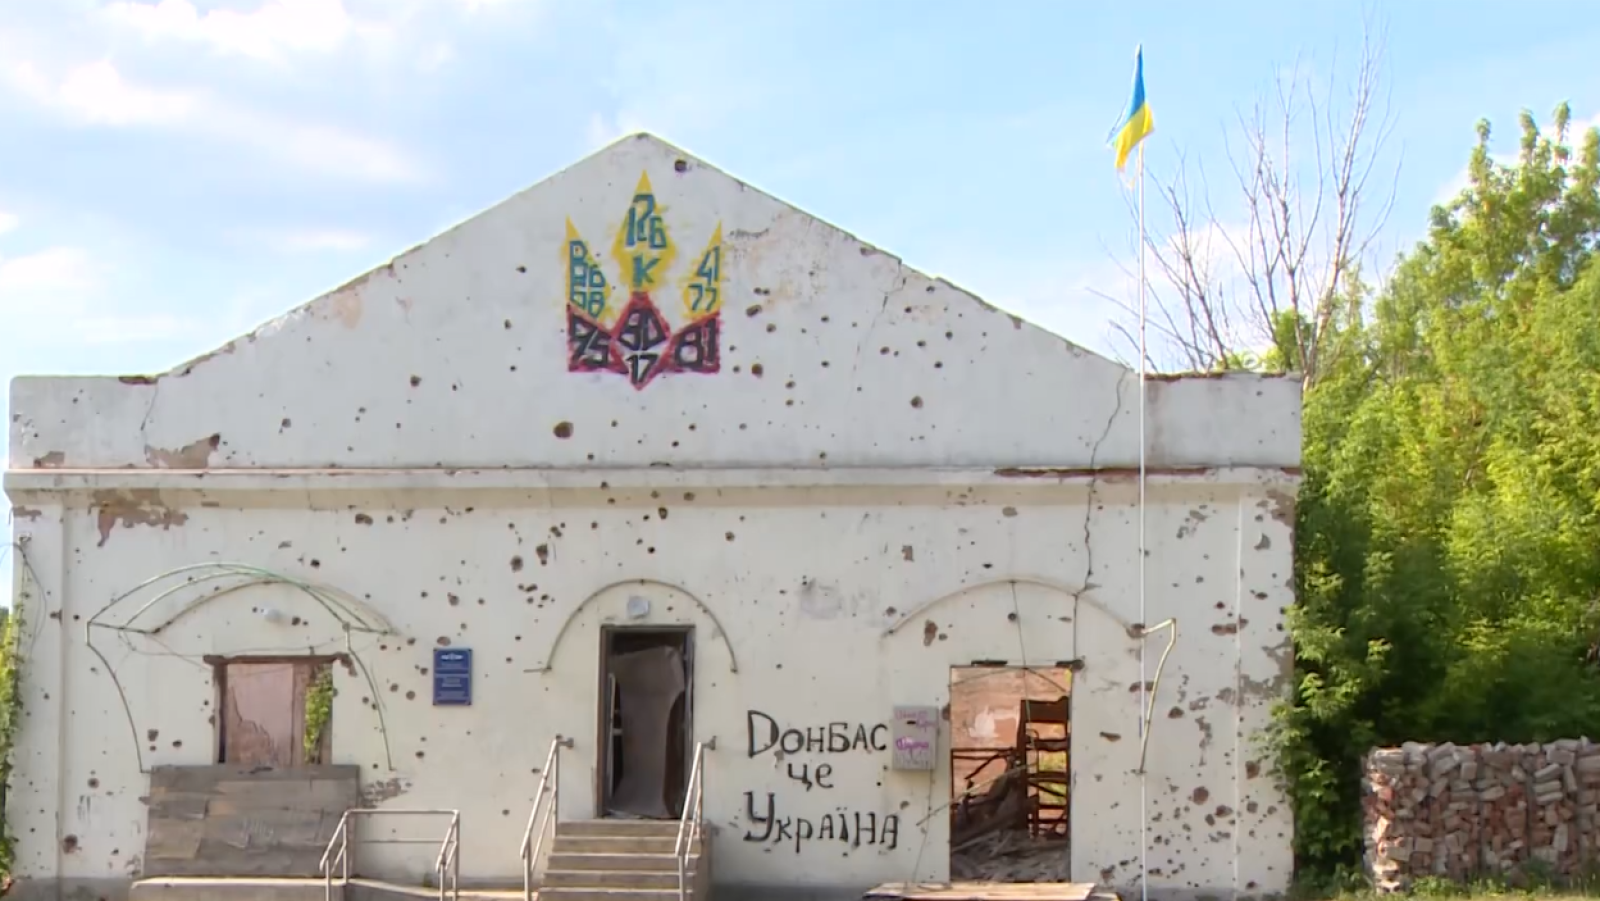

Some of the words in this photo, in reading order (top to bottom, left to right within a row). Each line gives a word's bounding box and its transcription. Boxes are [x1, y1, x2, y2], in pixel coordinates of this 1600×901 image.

[625, 194, 667, 249] 126
[697, 246, 720, 286] 41
[625, 353, 659, 385] 17
